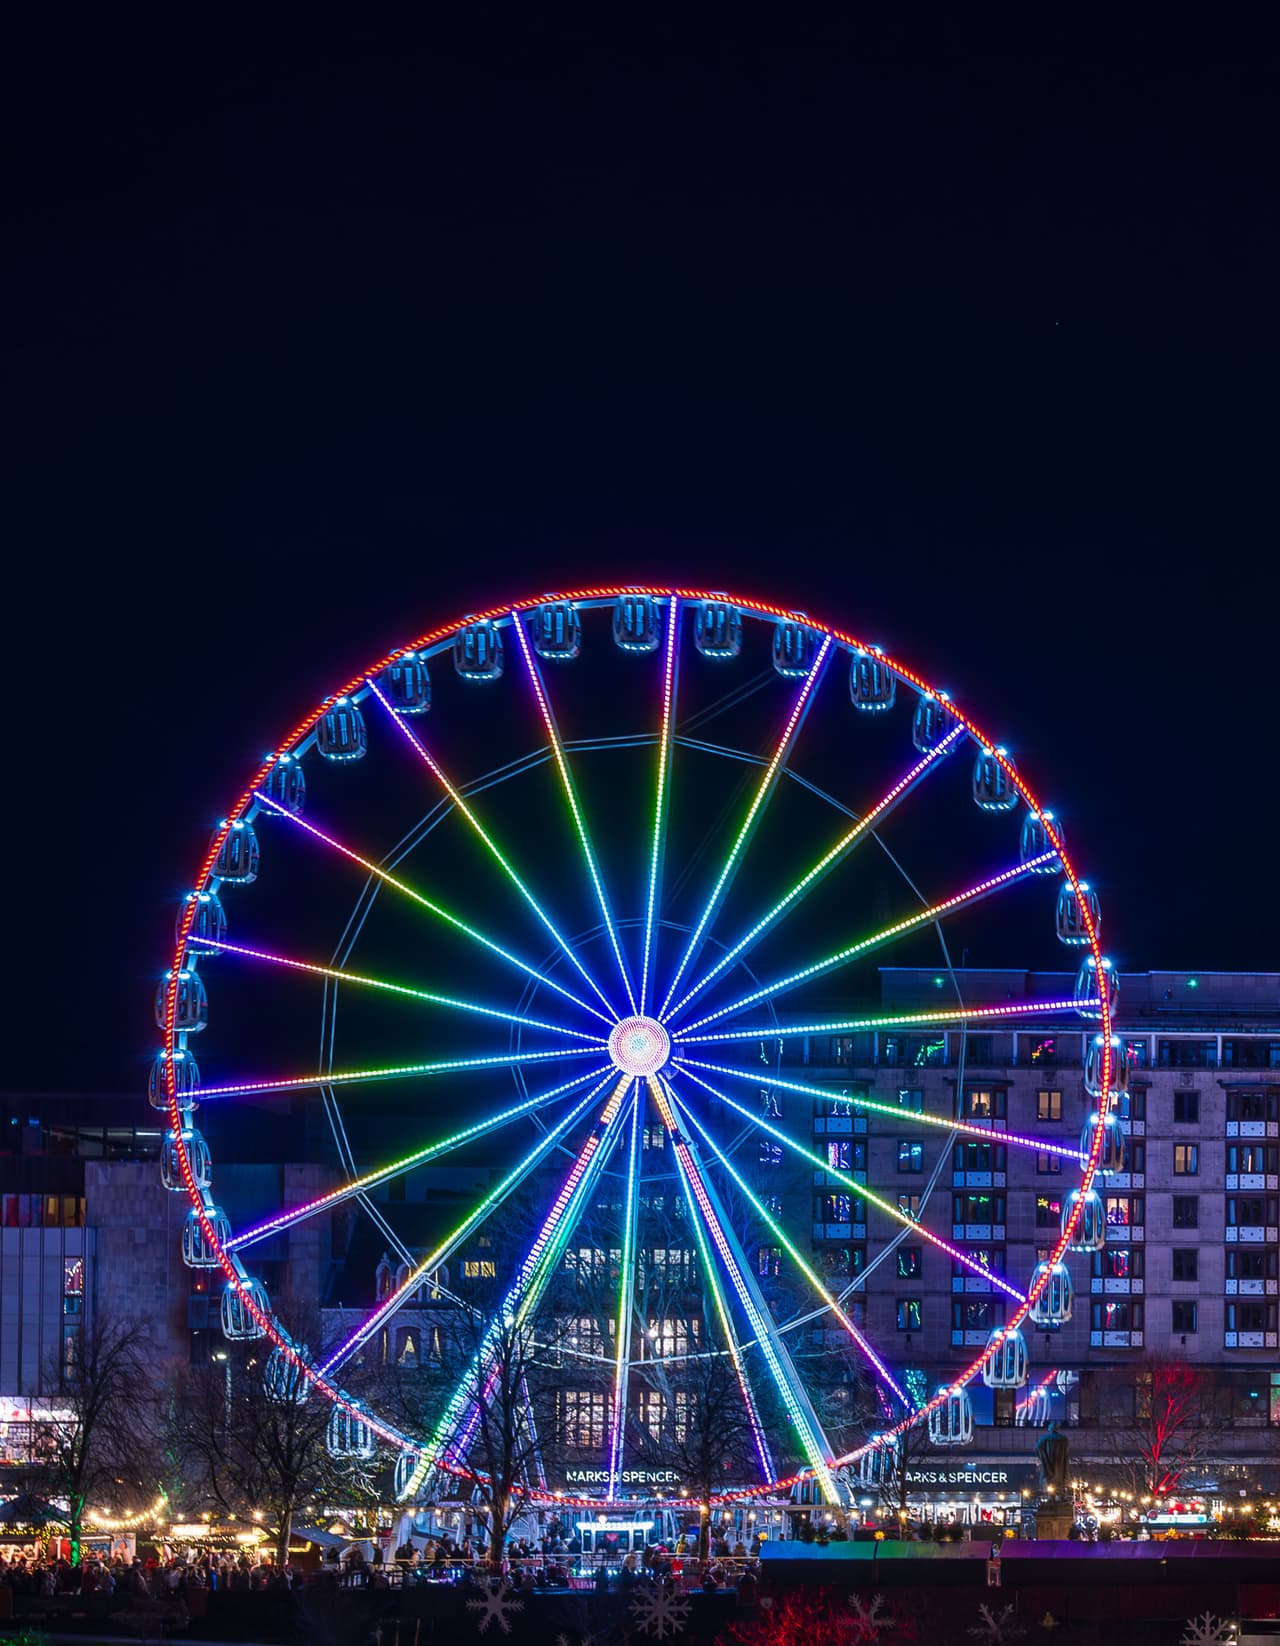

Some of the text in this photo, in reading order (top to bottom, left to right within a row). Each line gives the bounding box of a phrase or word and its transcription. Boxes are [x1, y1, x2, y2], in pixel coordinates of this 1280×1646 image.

[566, 1471, 610, 1483] MARKS
[905, 1472, 1008, 1483] ARKS & SPENCER
